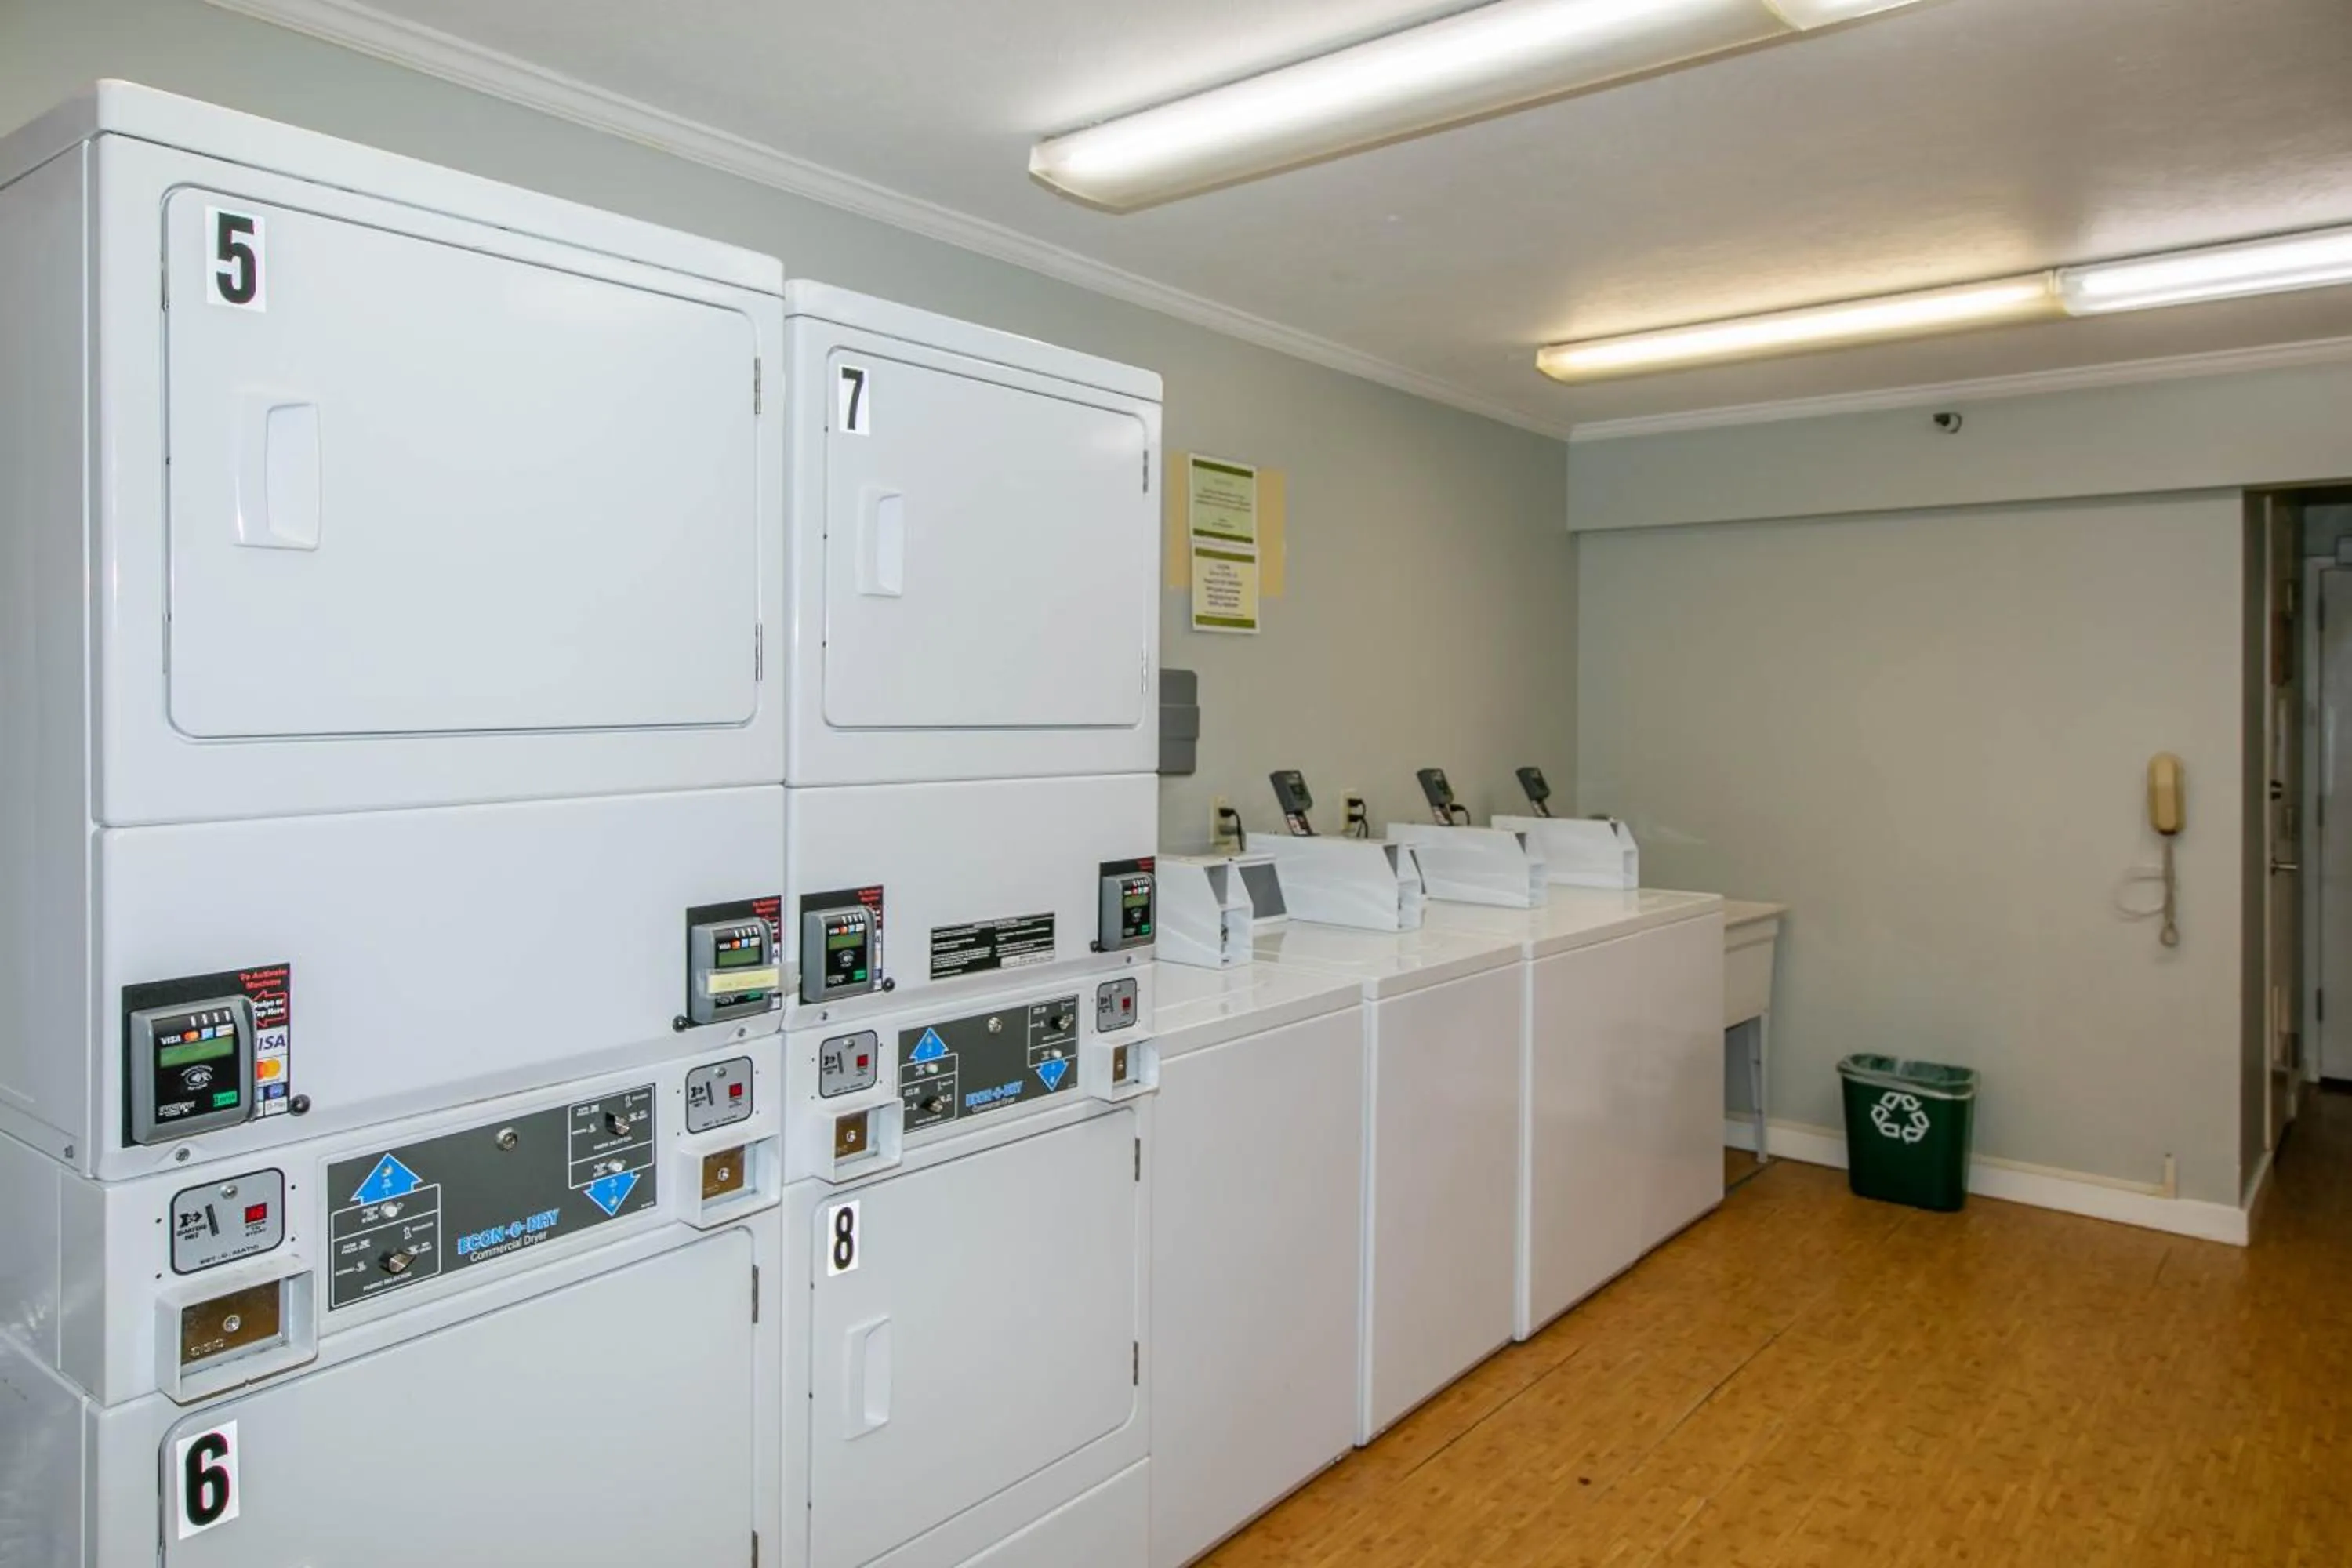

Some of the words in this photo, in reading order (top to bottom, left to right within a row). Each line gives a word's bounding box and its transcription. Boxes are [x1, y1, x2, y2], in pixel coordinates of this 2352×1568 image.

[216, 211, 256, 305] 5
[841, 366, 865, 430] 7
[160, 1034, 182, 1045] VISA
[256, 1033, 285, 1051] ISA
[457, 1207, 561, 1255] ECON-O-DRY
[470, 1236, 522, 1262] Commercial
[523, 1230, 547, 1246] Dryer
[833, 1207, 854, 1270] 8
[185, 1432, 230, 1526] 6
